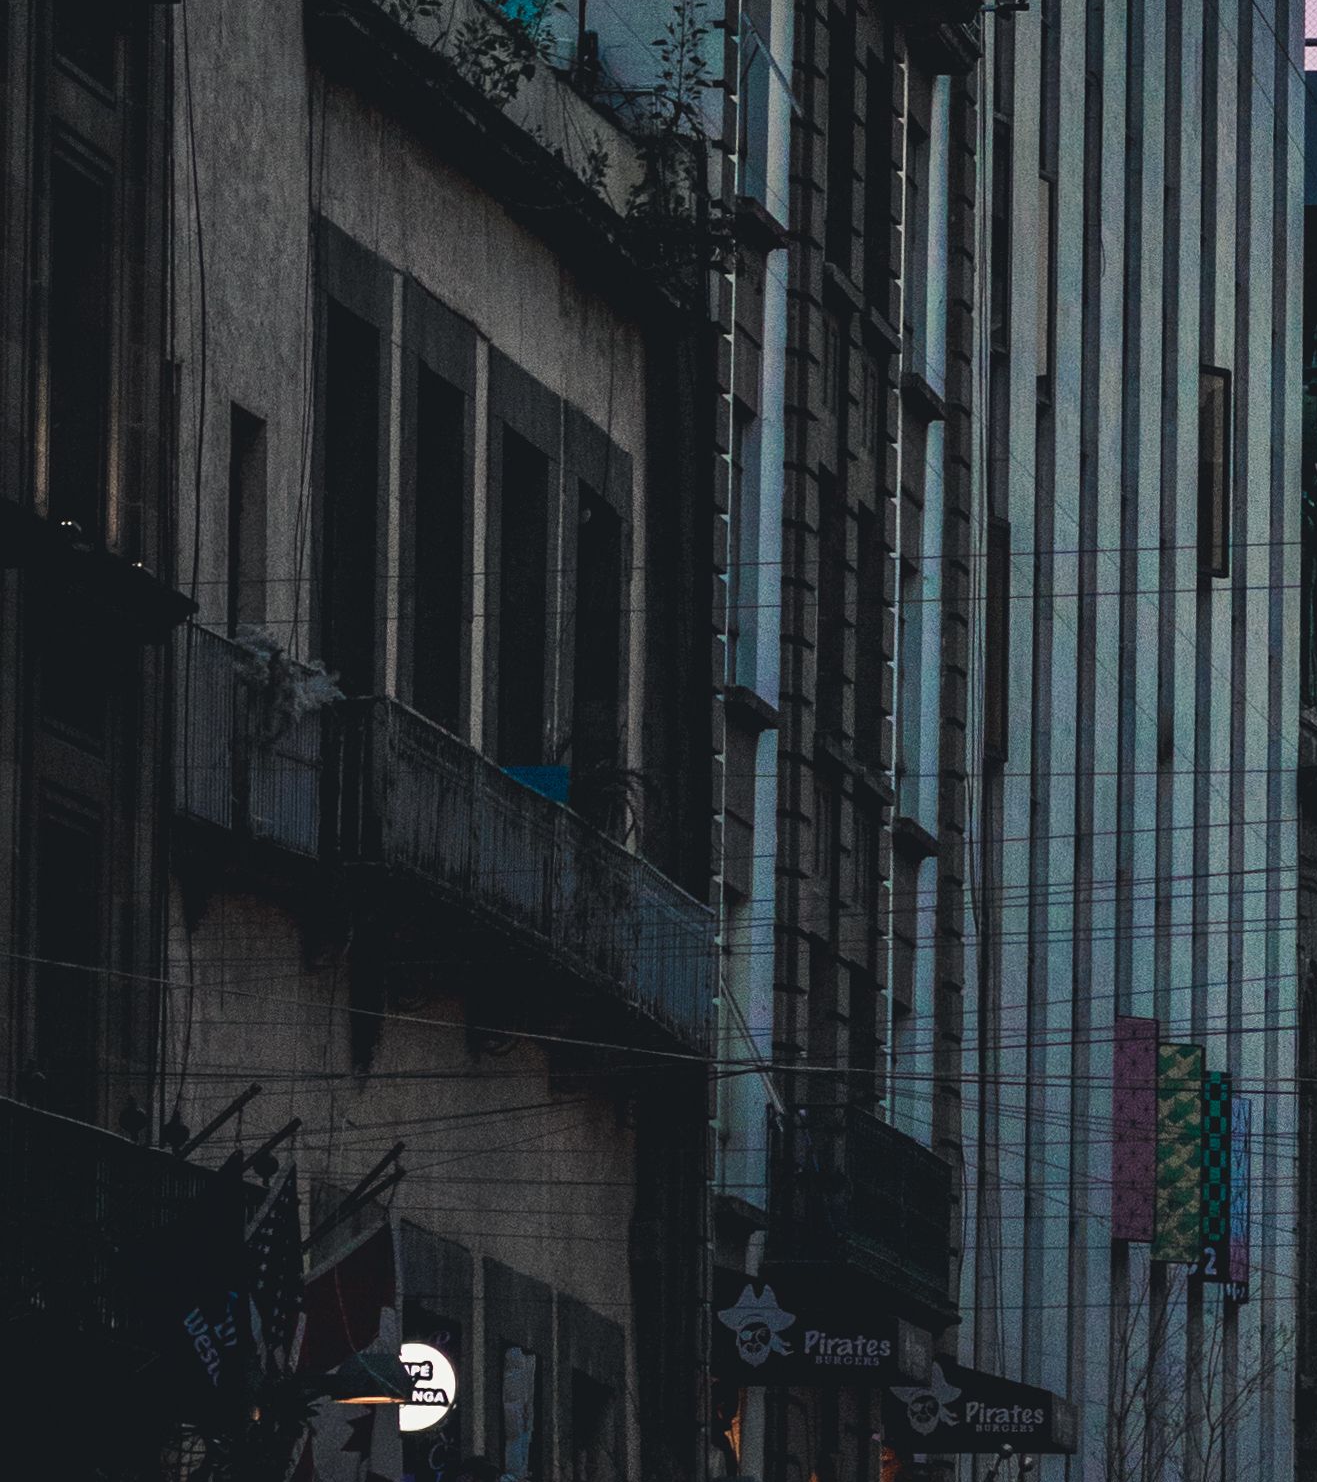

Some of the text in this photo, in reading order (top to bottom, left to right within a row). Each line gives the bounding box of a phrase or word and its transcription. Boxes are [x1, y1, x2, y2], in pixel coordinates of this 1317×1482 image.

[803, 1329, 892, 1357] Pirates
[814, 1355, 881, 1367] BURGERS
[964, 1401, 1045, 1425] Pirates
[975, 1423, 1035, 1434] BURGERS
